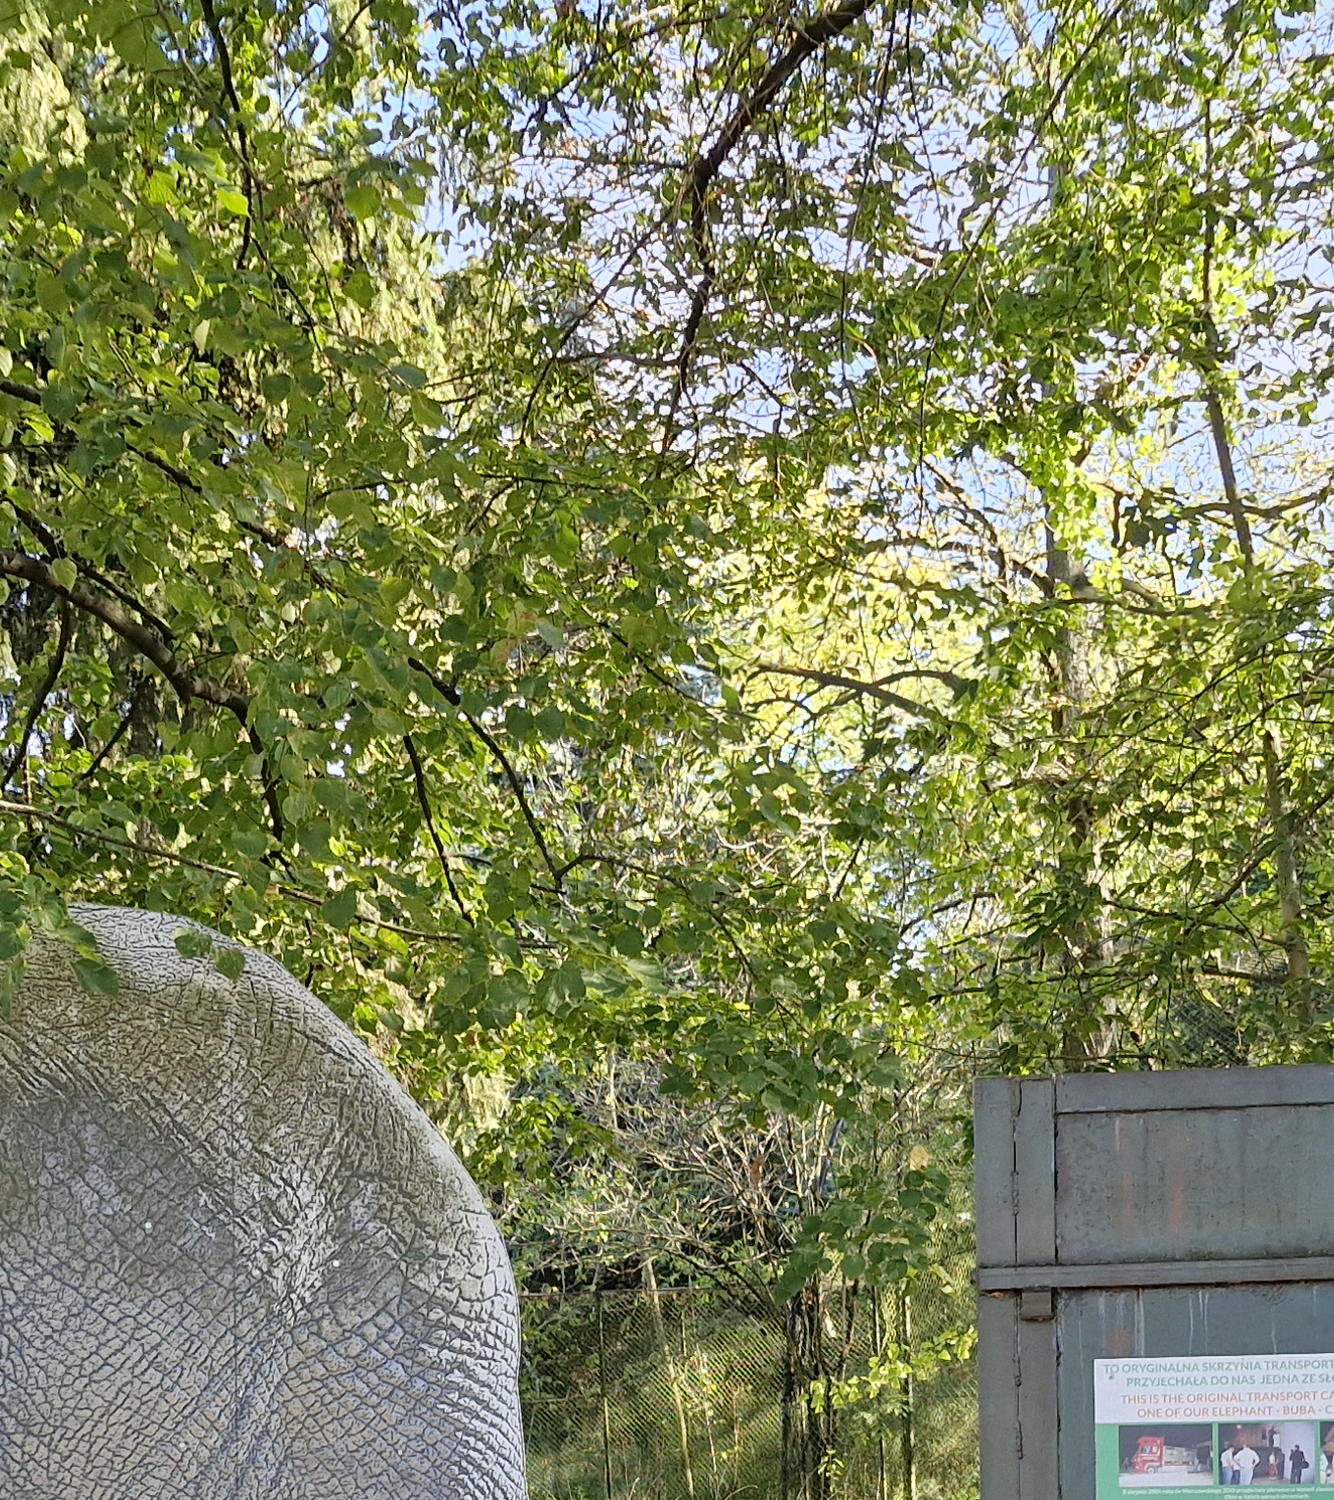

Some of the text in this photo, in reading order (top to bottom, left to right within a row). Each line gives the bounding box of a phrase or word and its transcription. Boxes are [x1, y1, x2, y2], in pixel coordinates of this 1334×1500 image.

[1104, 1364, 1120, 1375] TO
[1121, 1361, 1200, 1374] ORYGINALNA
[1126, 1375, 1208, 1388] PRZYJECHAŁA
[1210, 1375, 1230, 1386] DO
[1231, 1374, 1256, 1385] NAS
[1260, 1373, 1300, 1385] JEDNA
[1302, 1373, 1316, 1384] ZE
[1121, 1394, 1147, 1405] THIS
[1149, 1394, 1159, 1405] IS
[1162, 1393, 1186, 1404] THE
[1187, 1392, 1244, 1404] ORIGINAL
[1246, 1390, 1318, 1403] TRANSPORT
[1137, 1407, 1163, 1419] ONE
[1164, 1407, 1181, 1418] OF
[1183, 1407, 1210, 1418] OUR
[1212, 1405, 1273, 1417] ELEPHANT
[1282, 1404, 1317, 1416] BUBA
